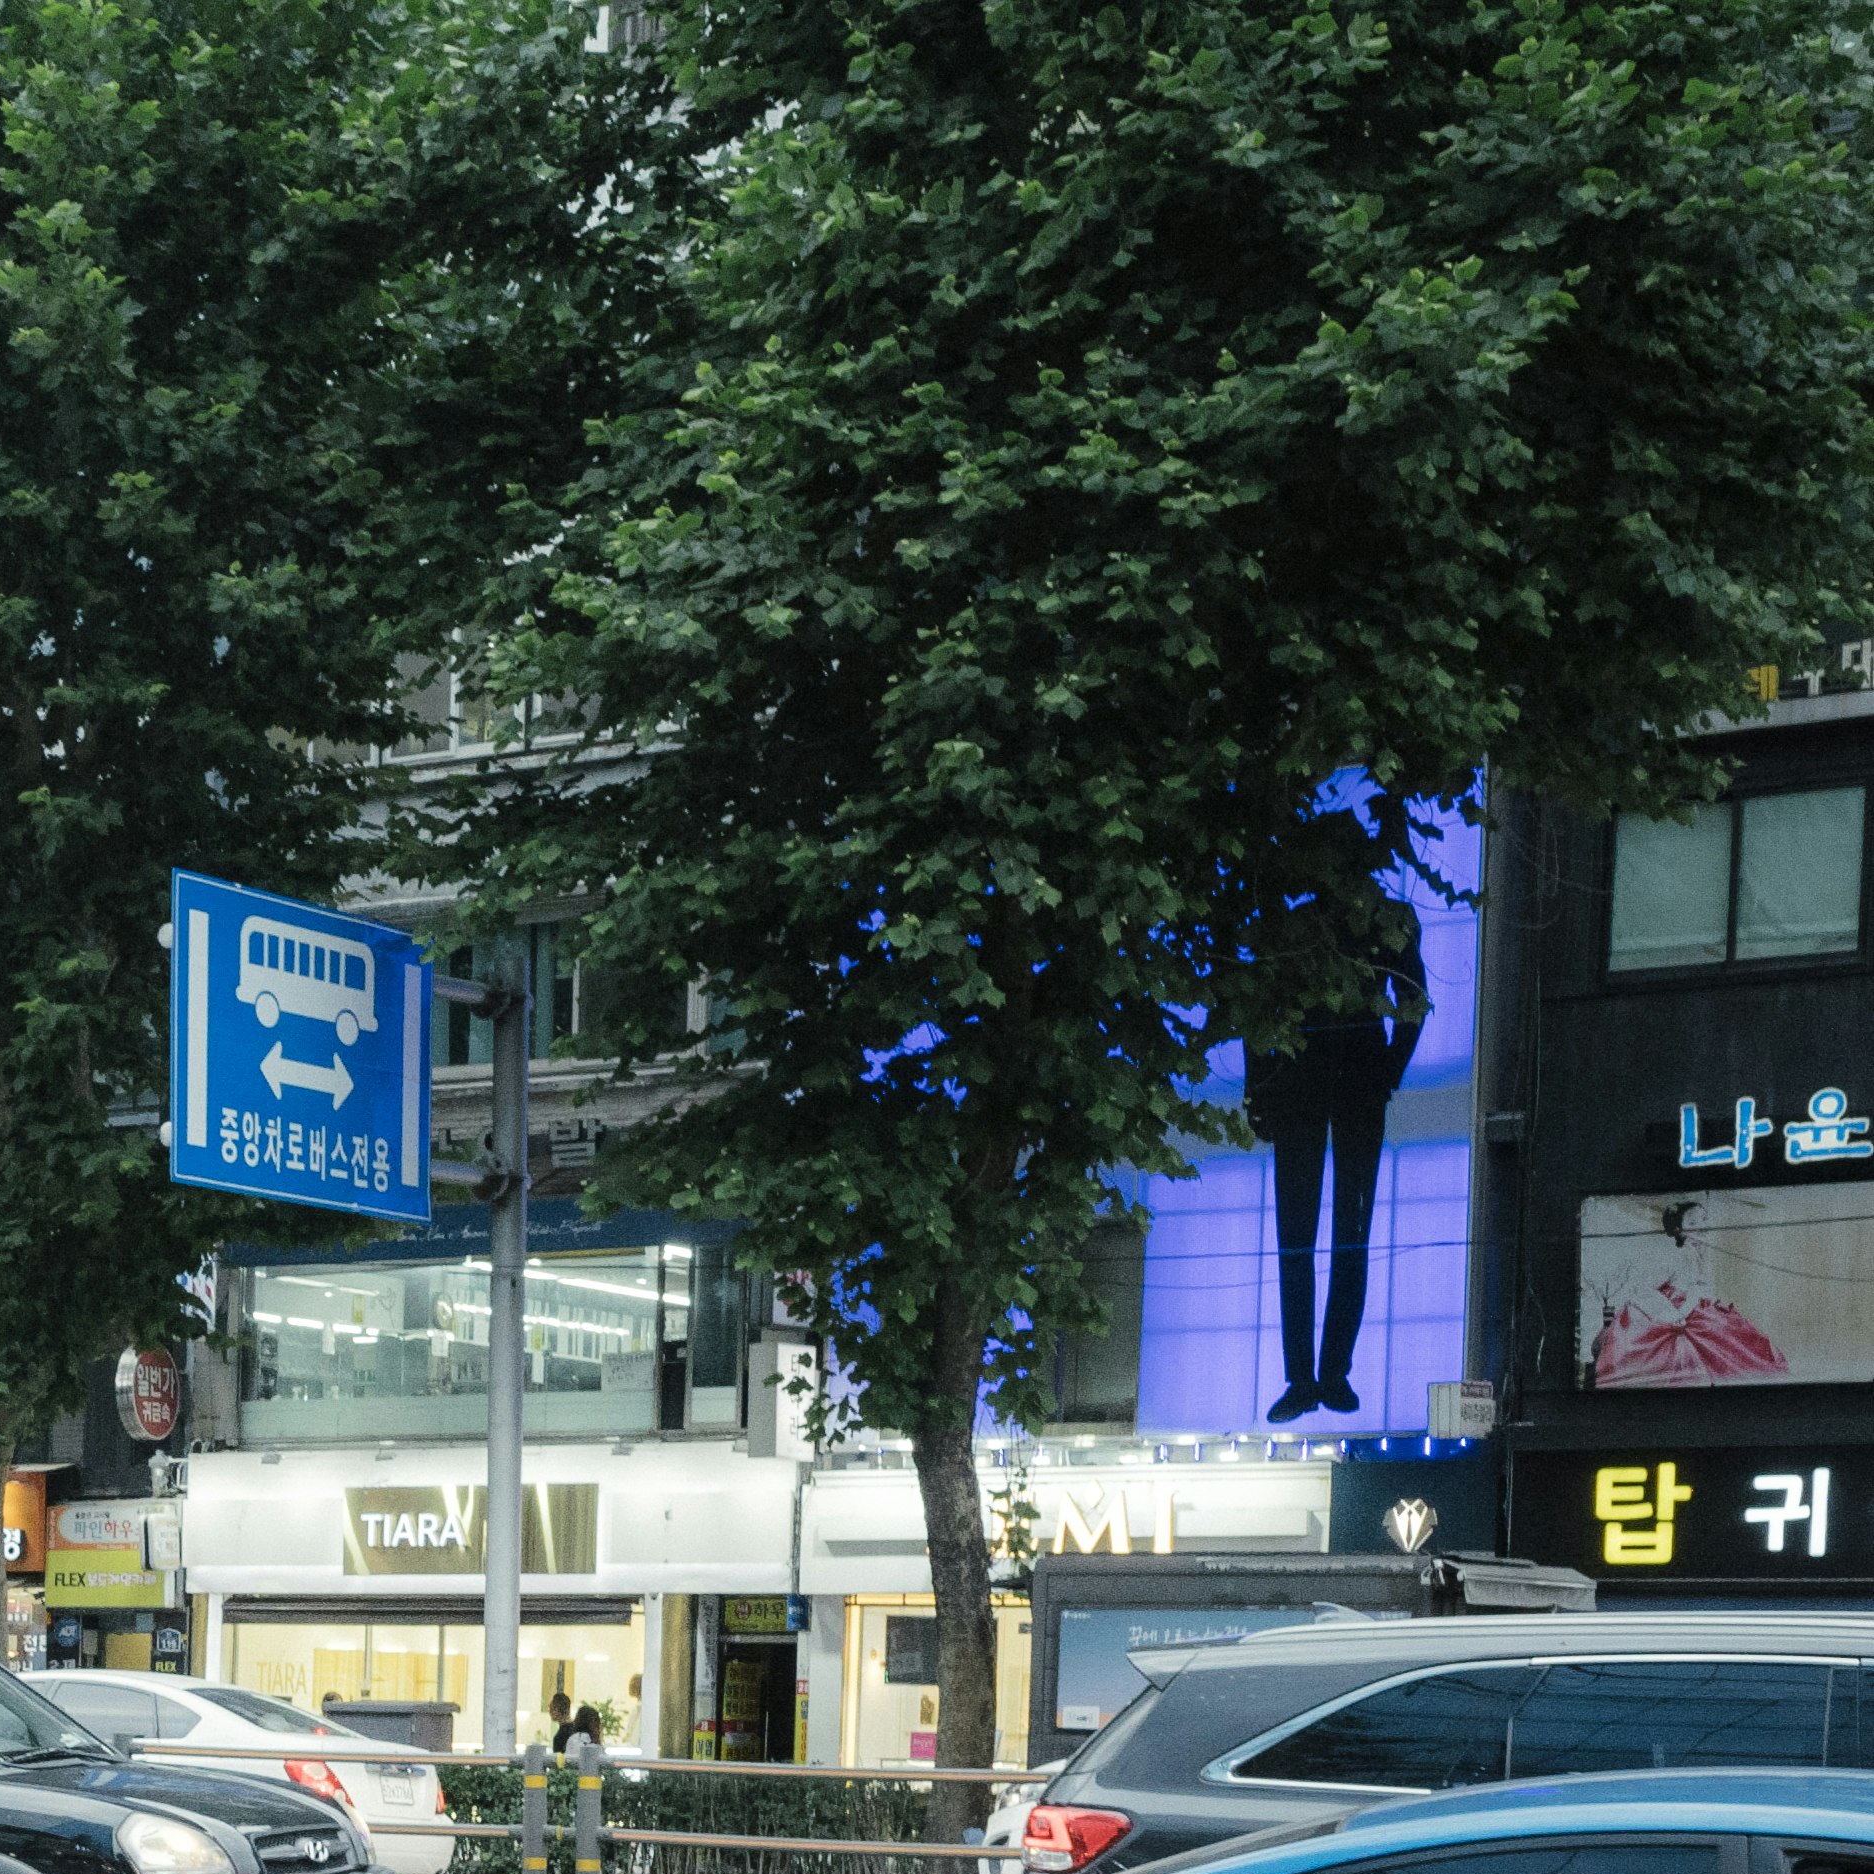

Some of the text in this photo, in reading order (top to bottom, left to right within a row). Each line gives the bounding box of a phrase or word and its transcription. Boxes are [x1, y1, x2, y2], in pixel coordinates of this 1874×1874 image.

[219, 1096, 391, 1193] 중앙차로버스전용
[136, 1364, 176, 1399] 일번가
[142, 1400, 171, 1423] 귀금속
[360, 1511, 468, 1548] TIARA
[1594, 1461, 1831, 1567] 탑 귀
[54, 1572, 86, 1587] FLEX
[155, 1661, 177, 1673] FLEX
[257, 1662, 307, 1695] TIARA
